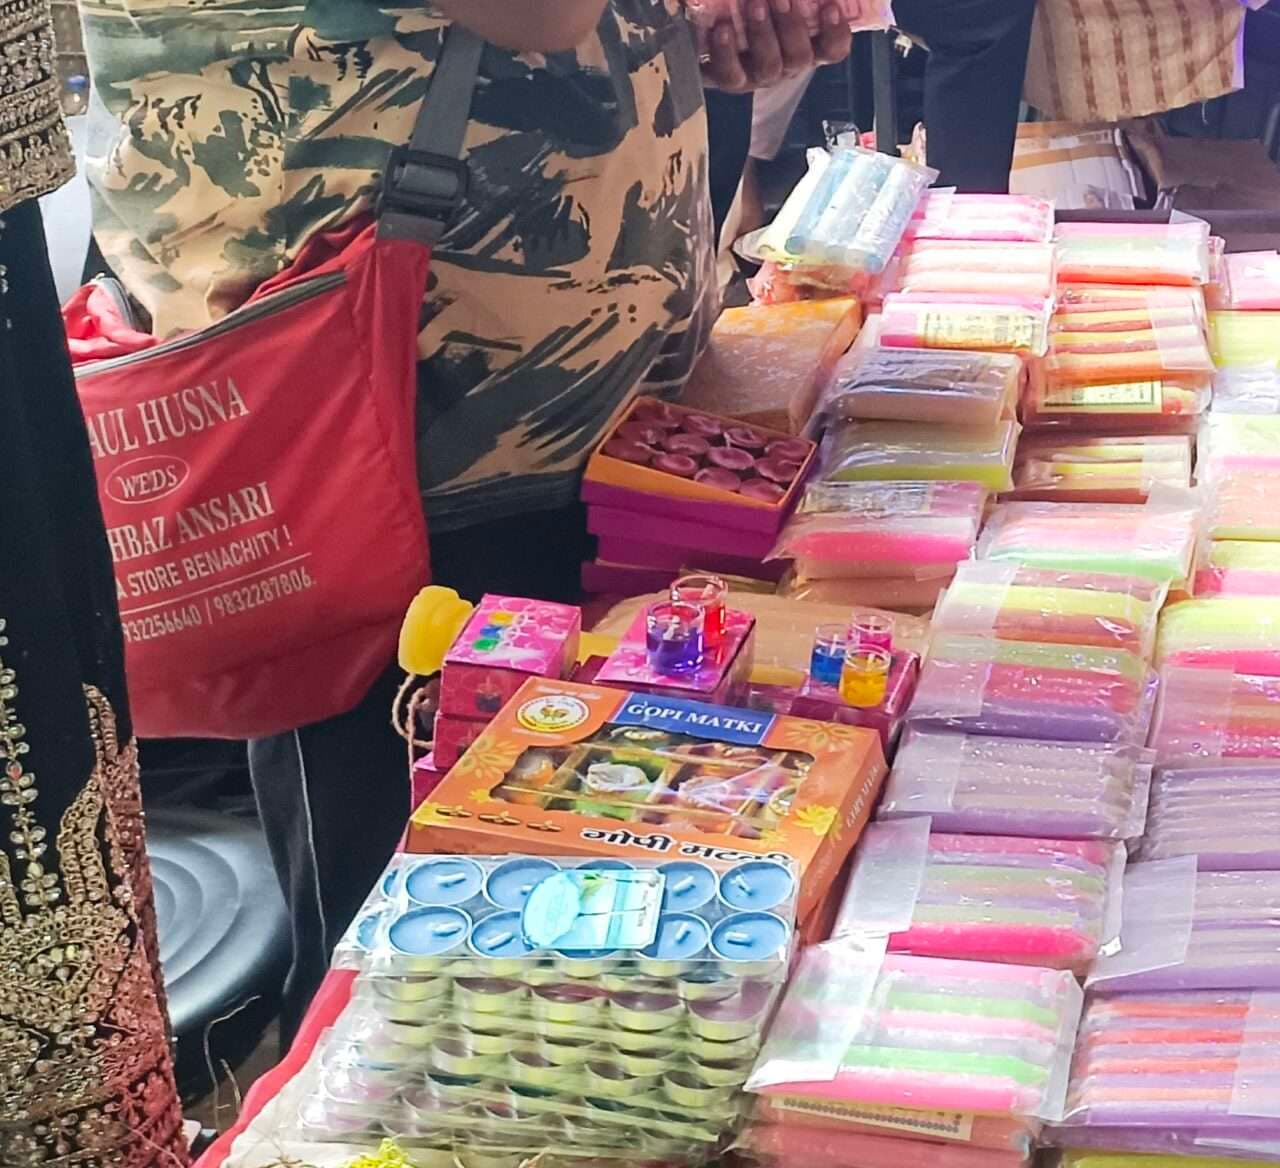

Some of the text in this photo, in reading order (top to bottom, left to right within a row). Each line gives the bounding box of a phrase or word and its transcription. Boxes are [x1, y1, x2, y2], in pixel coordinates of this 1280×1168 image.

[136, 377, 249, 446] HUSNA
[117, 464, 178, 499] WEDS
[106, 482, 275, 562] HBAZ ANSARI
[127, 563, 182, 597] STORE
[182, 528, 281, 581] BENACHITY
[627, 700, 763, 734] GOPI MATKI
[583, 829, 671, 851] गोपी
